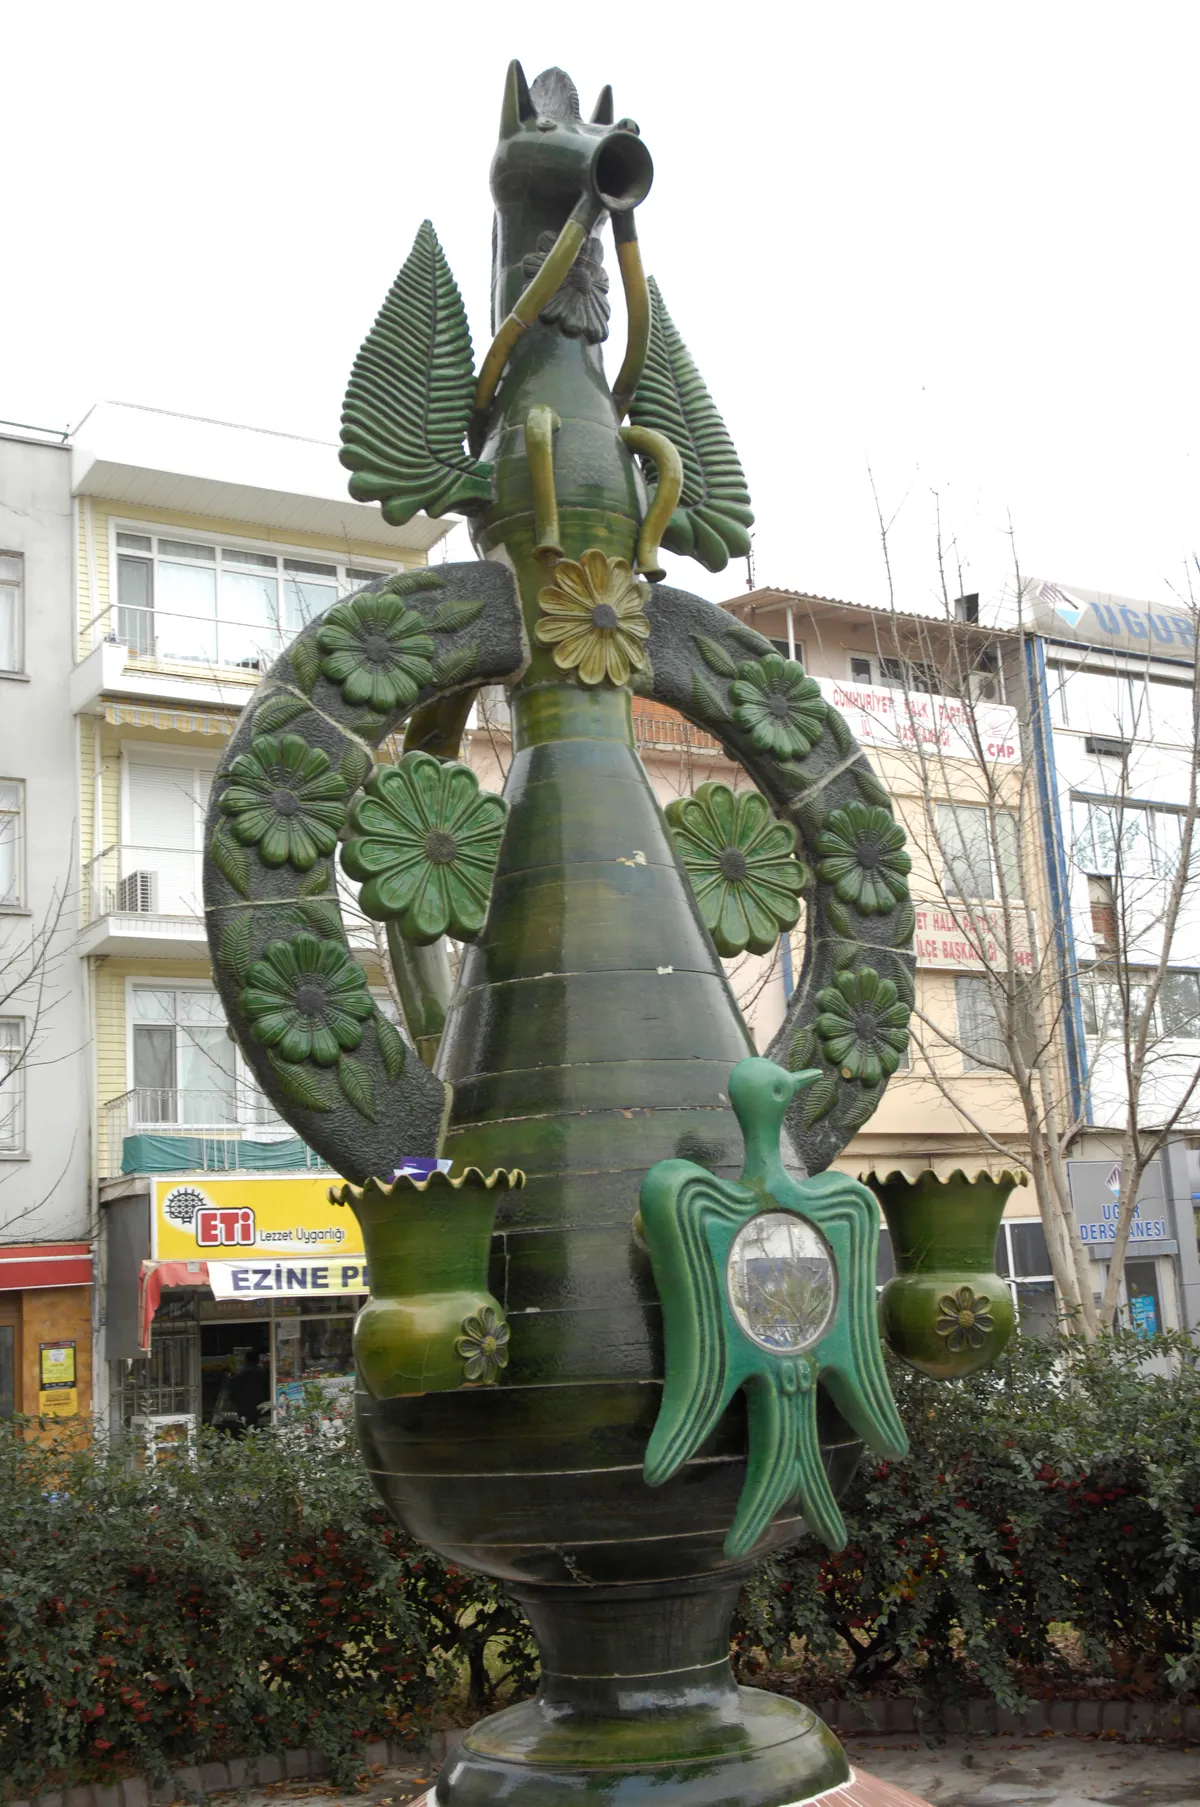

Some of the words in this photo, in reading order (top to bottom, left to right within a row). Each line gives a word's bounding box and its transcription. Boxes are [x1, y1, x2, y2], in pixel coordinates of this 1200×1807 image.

[987, 743, 1015, 759] CHP
[933, 912, 958, 932] HALK
[916, 934, 938, 963] İLÇE
[1015, 951, 1033, 967] HP
[1102, 1201, 1140, 1220] UĞR
[260, 1229, 293, 1241] Lezzet
[296, 1228, 345, 1243] Uygarlığı
[1080, 1216, 1166, 1240] DERSANESİ
[231, 1263, 329, 1291] EZİNE
